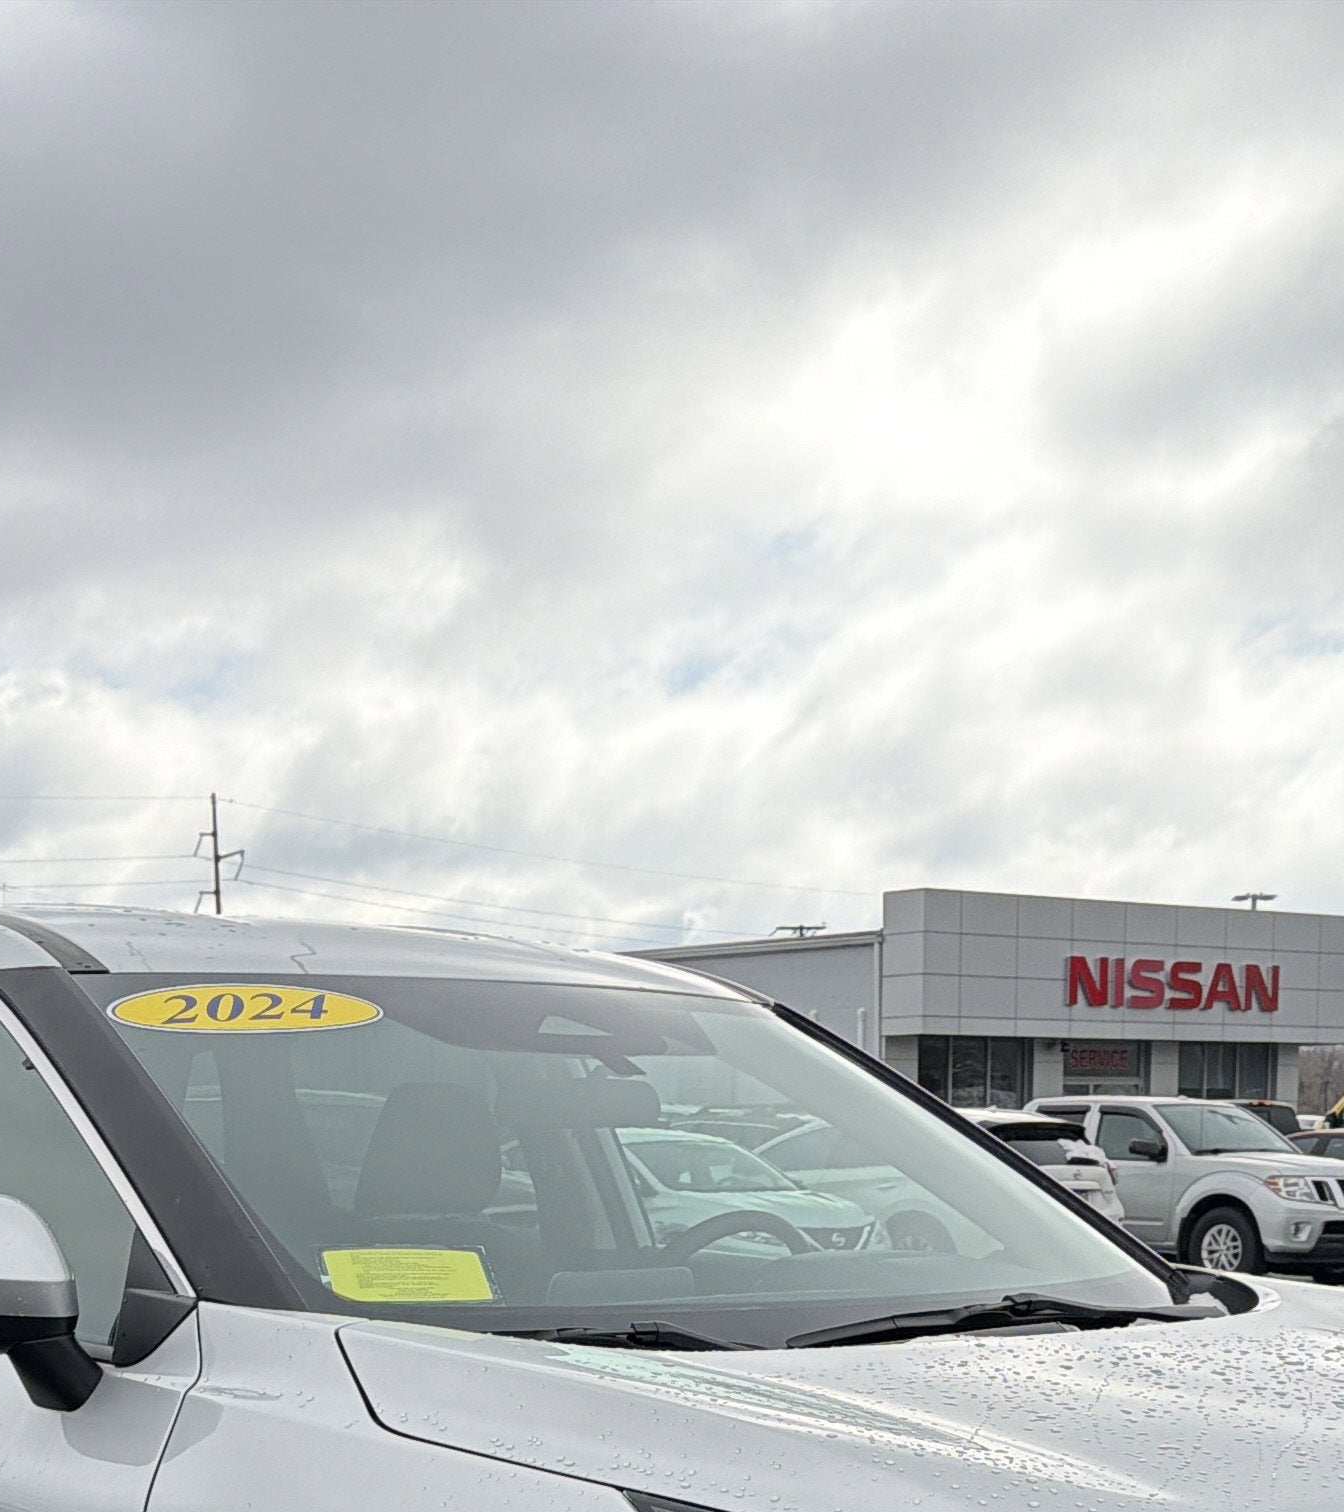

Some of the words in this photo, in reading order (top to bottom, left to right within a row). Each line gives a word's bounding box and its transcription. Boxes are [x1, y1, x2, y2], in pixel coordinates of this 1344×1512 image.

[1067, 956, 1280, 1012] NISSAN
[161, 992, 329, 1026] 2024
[1071, 1049, 1130, 1070] SERVICE
